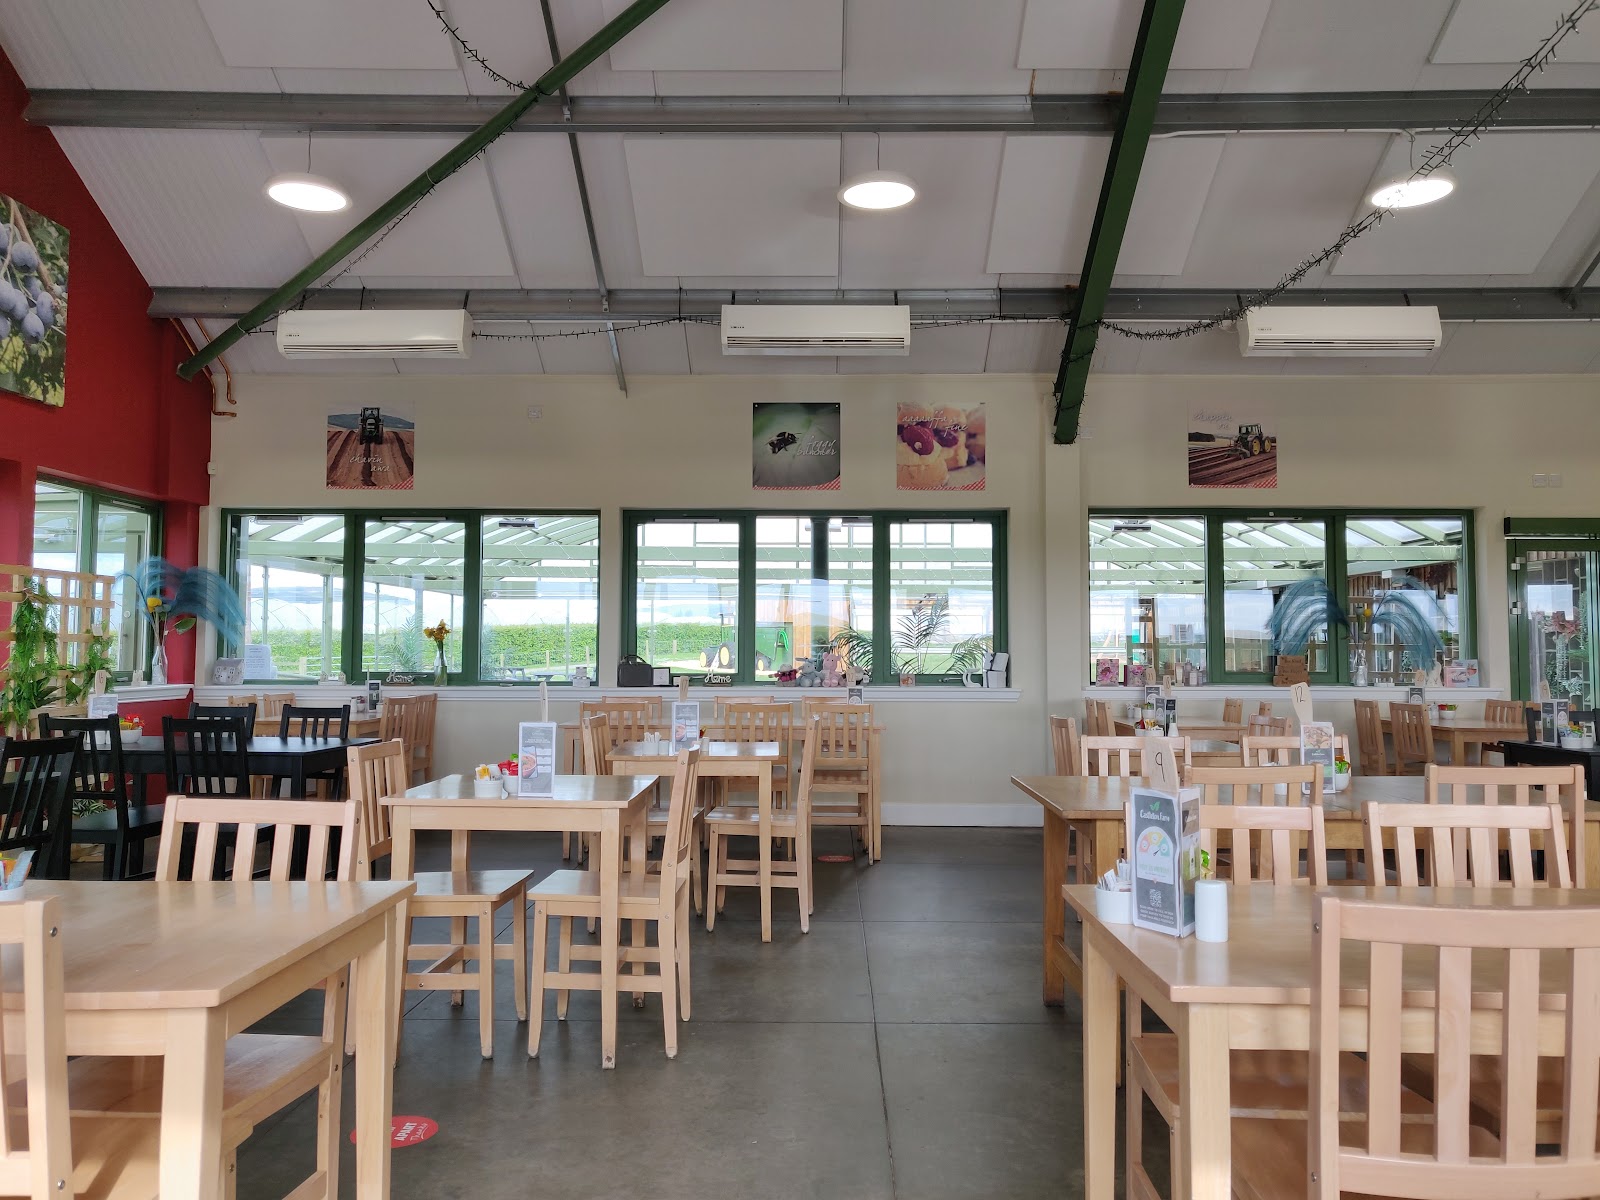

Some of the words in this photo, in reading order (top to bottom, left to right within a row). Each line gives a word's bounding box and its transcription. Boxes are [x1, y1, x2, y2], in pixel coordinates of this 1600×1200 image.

[704, 669, 732, 683] Home
[1295, 685, 1306, 703] 12
[1155, 751, 1166, 783] 9
[1140, 809, 1160, 821] Castleton
[394, 1122, 417, 1141] APART
